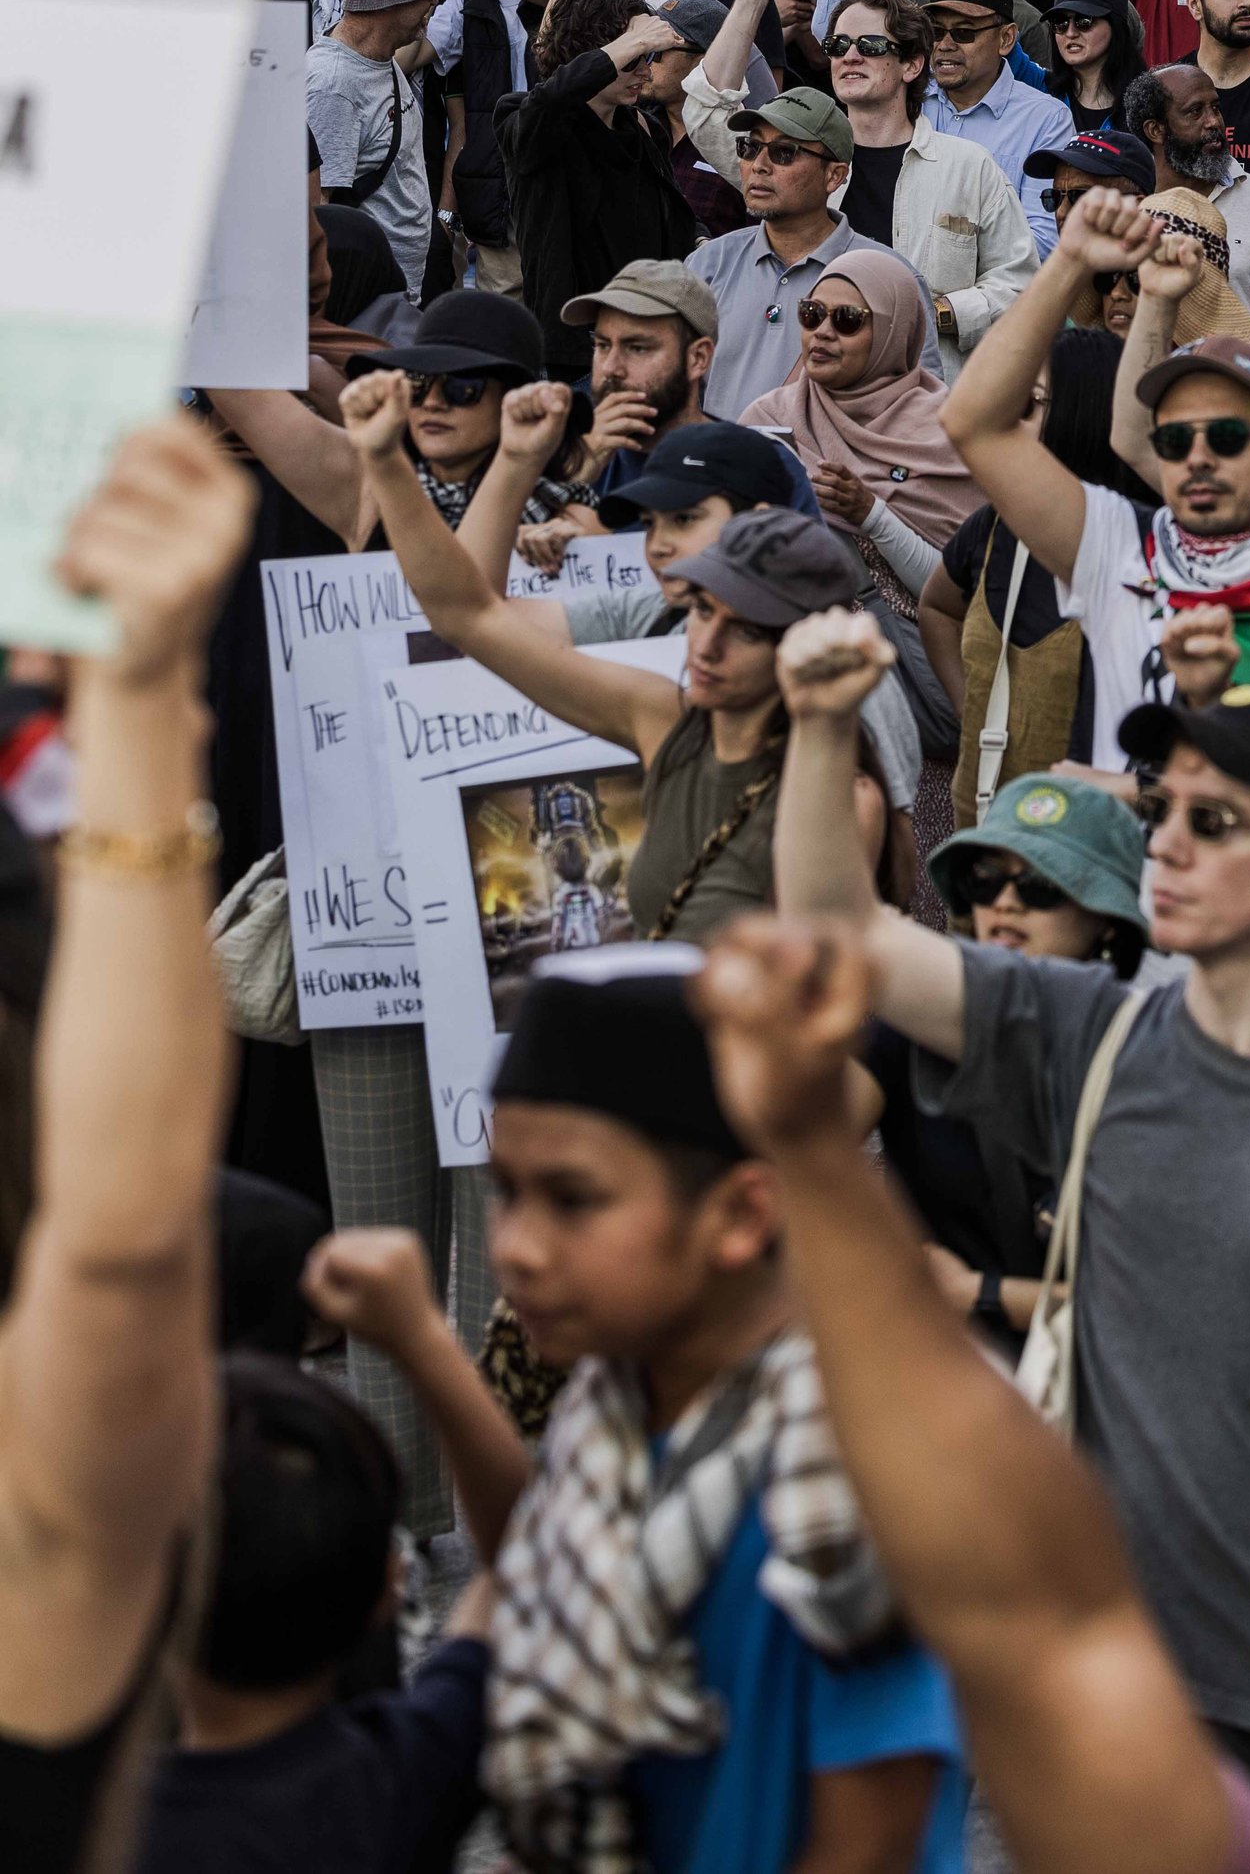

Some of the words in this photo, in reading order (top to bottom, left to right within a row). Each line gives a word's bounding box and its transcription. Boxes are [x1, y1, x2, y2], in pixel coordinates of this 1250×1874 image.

[294, 570, 360, 639] HOW
[563, 554, 595, 589] THE
[303, 700, 347, 753] THE
